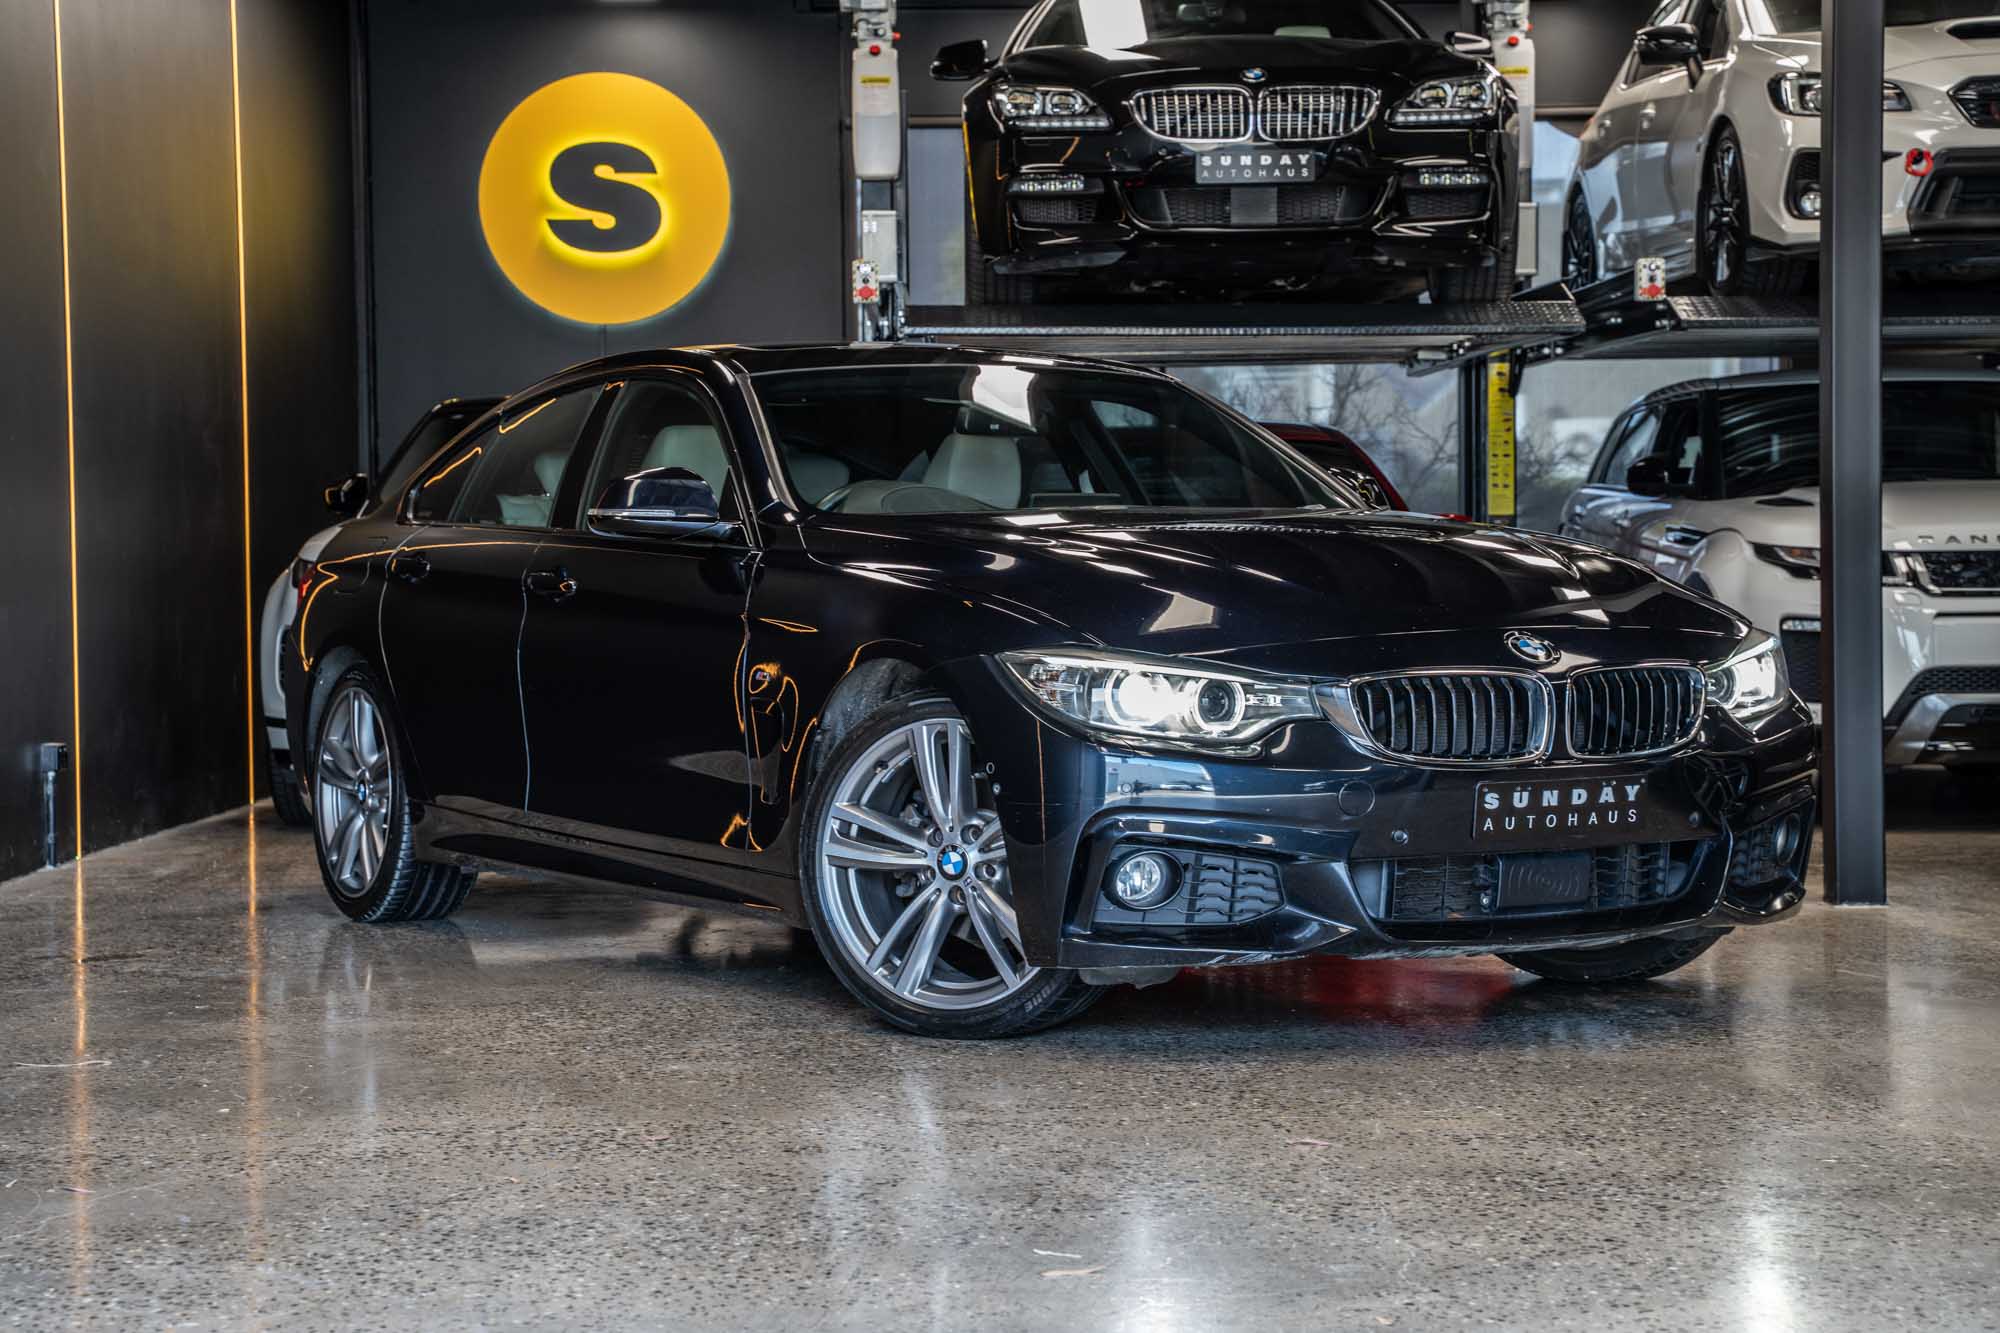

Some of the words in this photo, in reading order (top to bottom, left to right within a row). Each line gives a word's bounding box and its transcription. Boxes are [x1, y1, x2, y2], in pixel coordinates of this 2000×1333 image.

[1201, 154, 1310, 166] SUNDAY
[1202, 168, 1308, 178] AUTOHAUS
[546, 141, 662, 253] S
[1483, 785, 1640, 810] SUNDAY
[1483, 809, 1637, 831] AUTOHAUS
